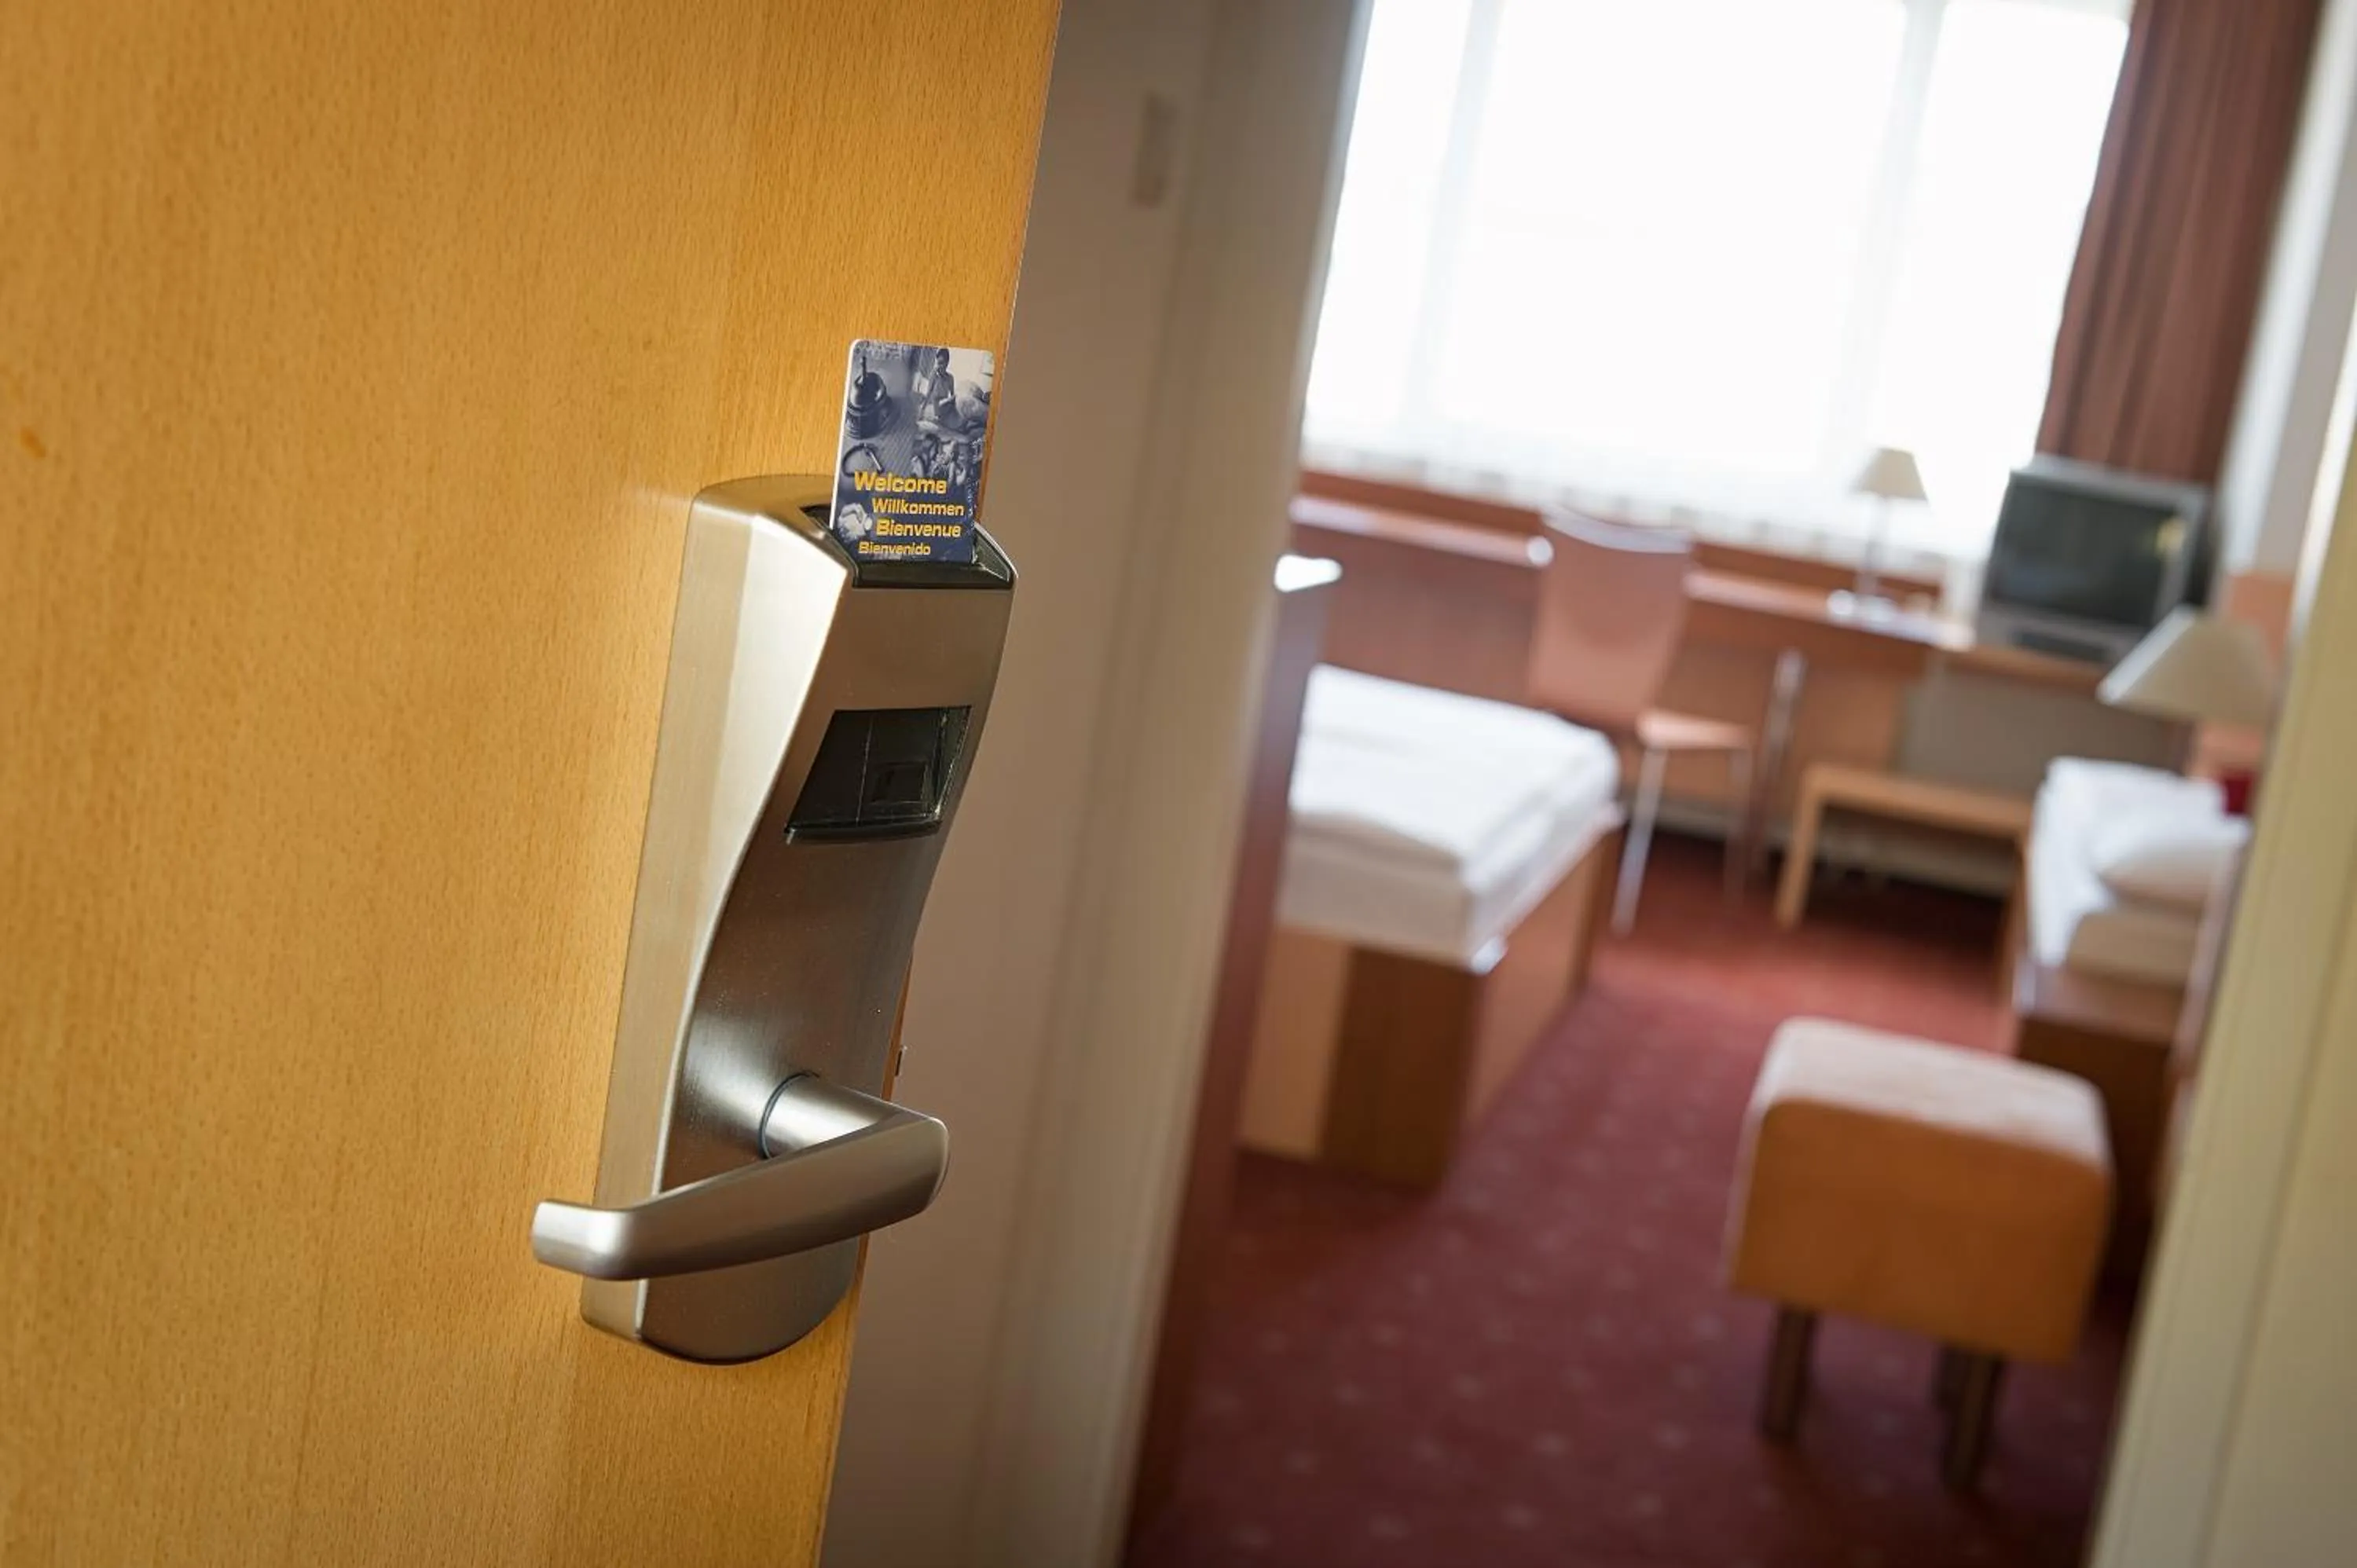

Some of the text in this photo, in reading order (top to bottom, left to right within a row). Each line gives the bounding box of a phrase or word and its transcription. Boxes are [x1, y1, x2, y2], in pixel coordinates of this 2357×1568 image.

[854, 471, 947, 494] Welcome
[871, 496, 965, 516] Willkommen
[875, 518, 962, 537] Bienvenue
[858, 540, 931, 556] Bienvenido
